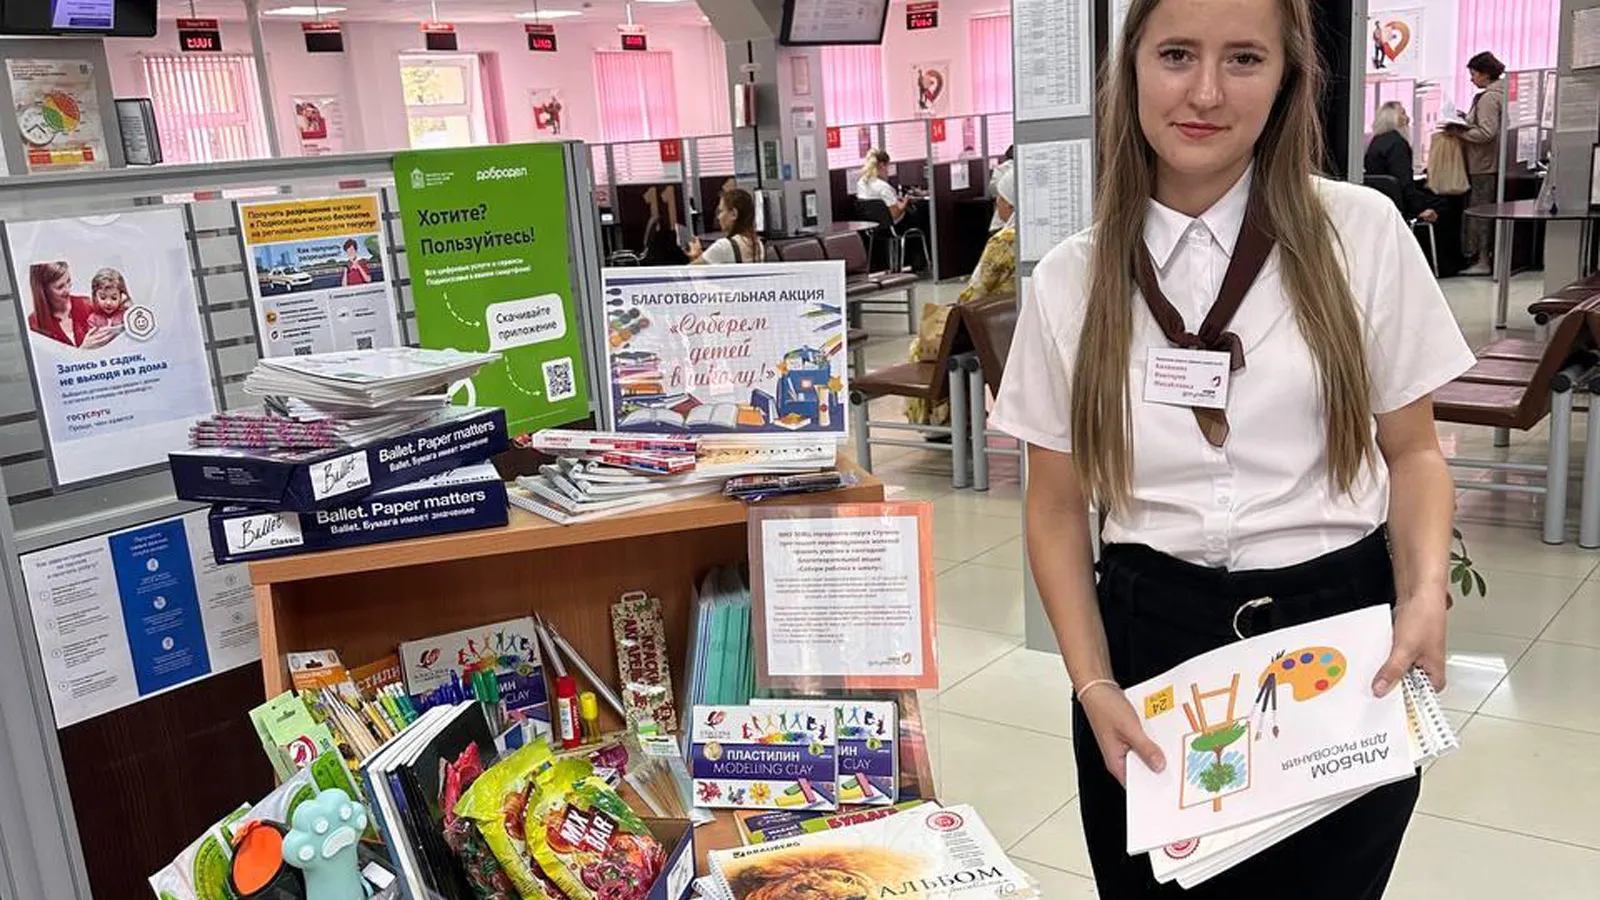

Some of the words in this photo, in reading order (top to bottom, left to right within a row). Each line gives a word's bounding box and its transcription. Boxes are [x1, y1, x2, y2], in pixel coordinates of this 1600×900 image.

[476, 166, 528, 182] добродел
[248, 209, 284, 219] Получить
[286, 206, 331, 218] разрешение
[256, 217, 307, 227] Подмосковье
[417, 203, 488, 227] Хотите?
[421, 227, 535, 256] Пользуйтесь!
[631, 291, 776, 306] БЛАГОТВОРИТЕЛЬНАЯ
[779, 289, 825, 302] АКЦИЯ
[496, 306, 551, 324] Скачивайте
[669, 310, 770, 336] «Соберем
[498, 321, 557, 340] приложение
[689, 339, 752, 365] детей
[57, 360, 98, 375] Запись
[110, 353, 146, 367] садик,
[59, 377, 75, 387] не
[77, 369, 121, 385] выходя
[123, 367, 136, 377] из
[139, 362, 168, 374] дома
[670, 365, 683, 387] в
[687, 363, 776, 388] школу!»
[66, 408, 111, 422] госуслуги
[379, 444, 415, 463] Ballet.
[417, 432, 453, 450] Paper
[453, 420, 496, 440] matters
[411, 451, 437, 466] Бумага
[321, 454, 357, 495] Ballet
[346, 477, 369, 488] Classic
[316, 507, 368, 525] Ballet.
[372, 498, 422, 517] Paper
[423, 490, 486, 509] matters
[238, 514, 285, 550] Ballet
[330, 522, 361, 535] Ballet.
[363, 516, 399, 530] Бумага
[400, 513, 429, 526] имеет
[430, 507, 476, 521] значение
[271, 536, 301, 546] Classic
[1150, 695, 1168, 715] 24
[1360, 732, 1388, 749] ДЛЯ
[727, 750, 800, 761] ПЛАСТИЛИН
[843, 758, 872, 769] CLAY
[1281, 740, 1358, 770] РИСОВАНИЯ
[1311, 745, 1390, 779] АЛЬБОМ
[713, 763, 782, 775] MODELLING
[786, 763, 814, 775] CLAY
[585, 814, 615, 852] BAR
[879, 866, 1004, 899] АЛЬБОМ
